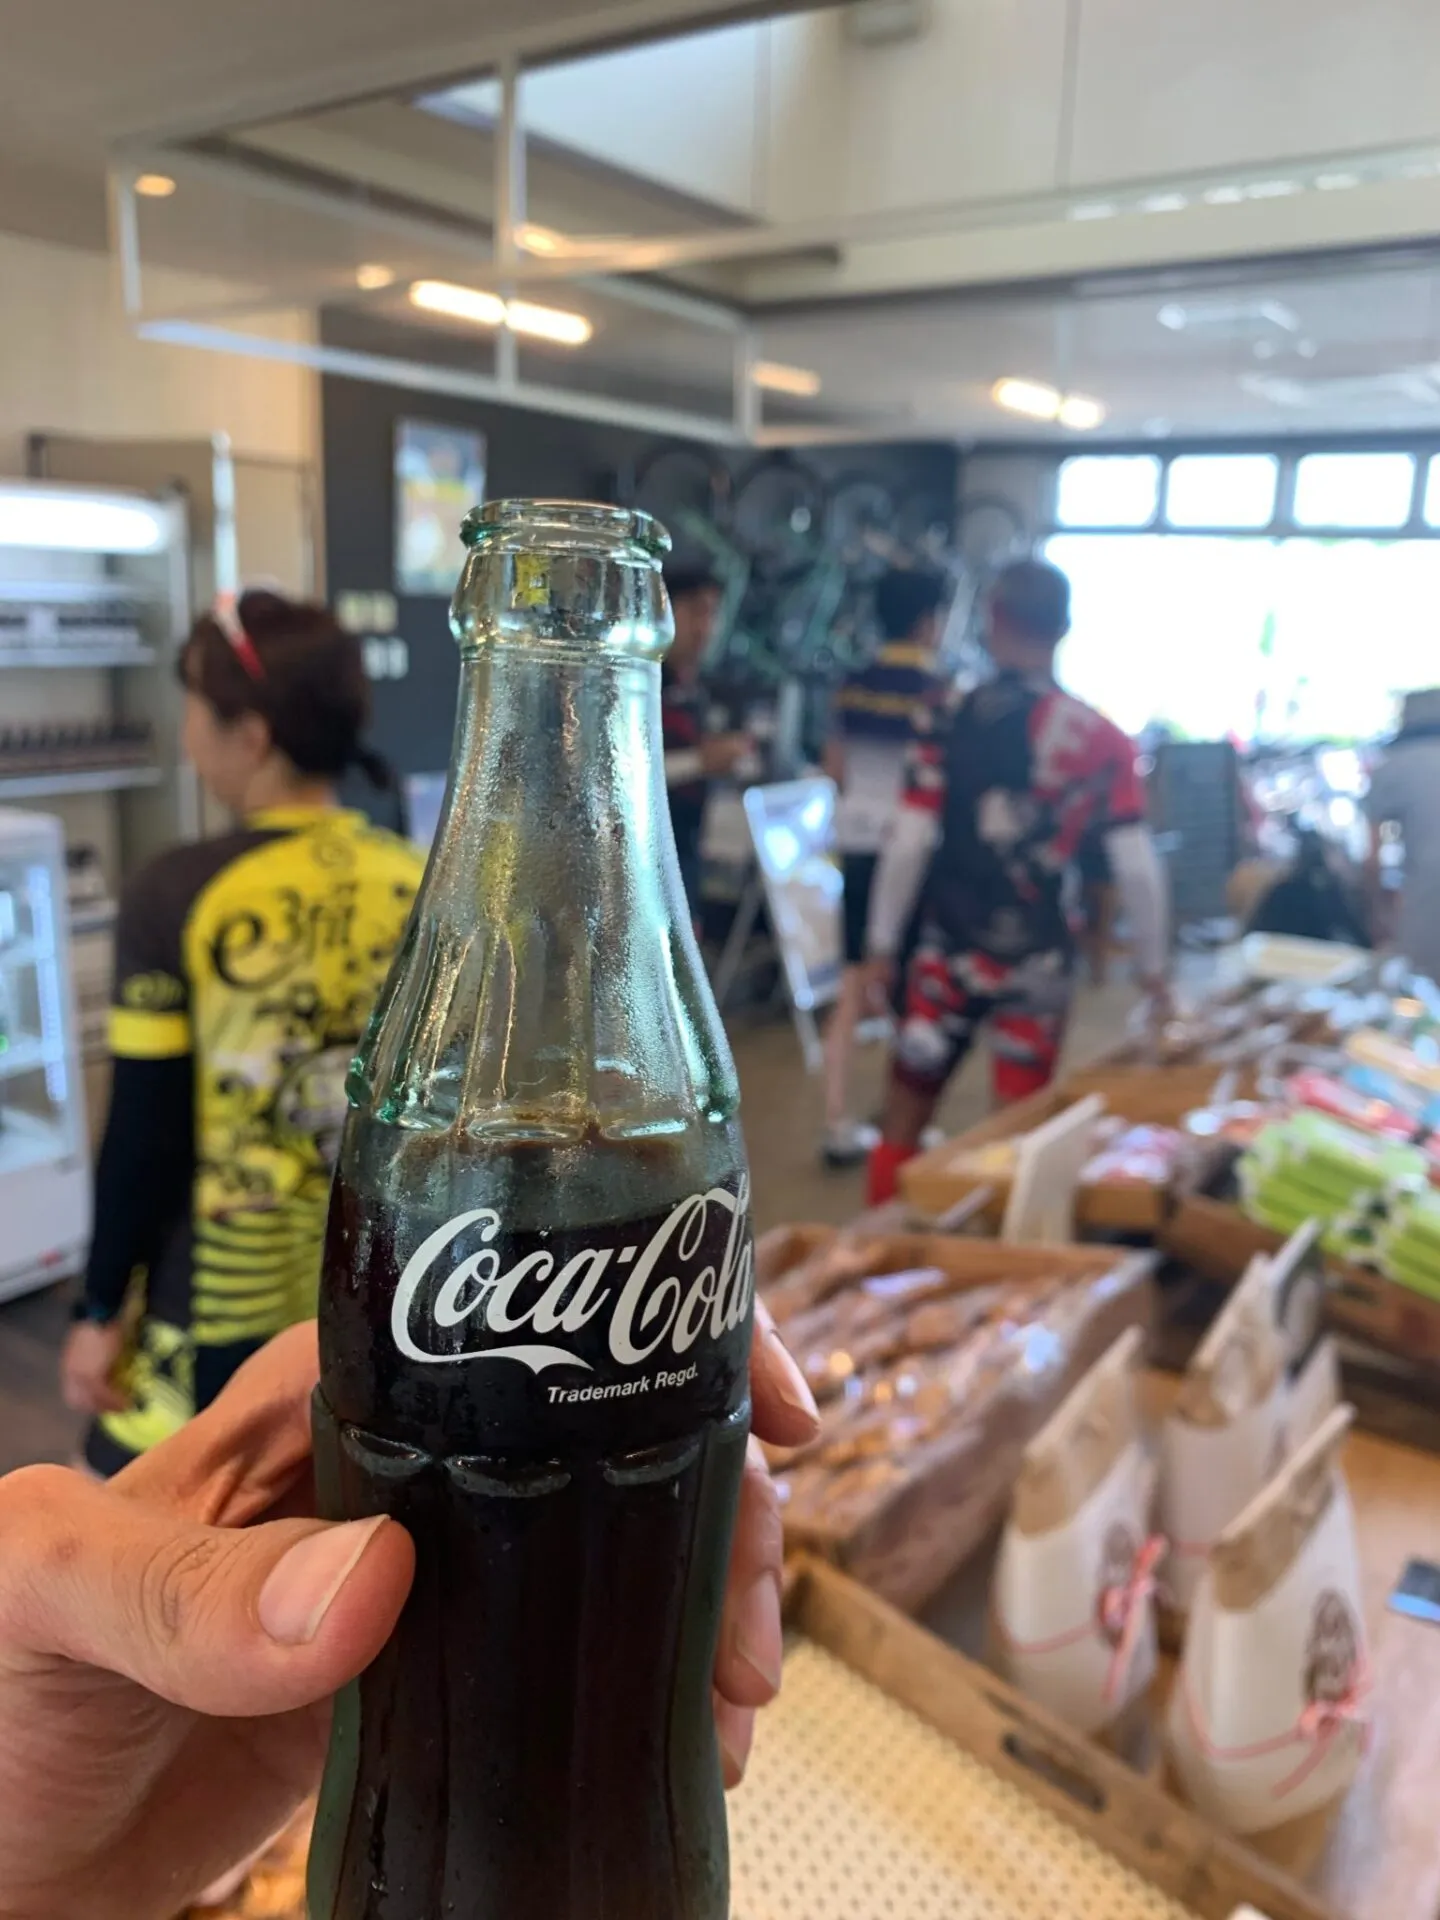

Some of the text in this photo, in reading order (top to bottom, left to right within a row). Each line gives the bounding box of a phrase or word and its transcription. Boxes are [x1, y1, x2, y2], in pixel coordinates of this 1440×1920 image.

[391, 1172, 753, 1375] Coca-Cola
[547, 1362, 699, 1404] Trademark Regd.
